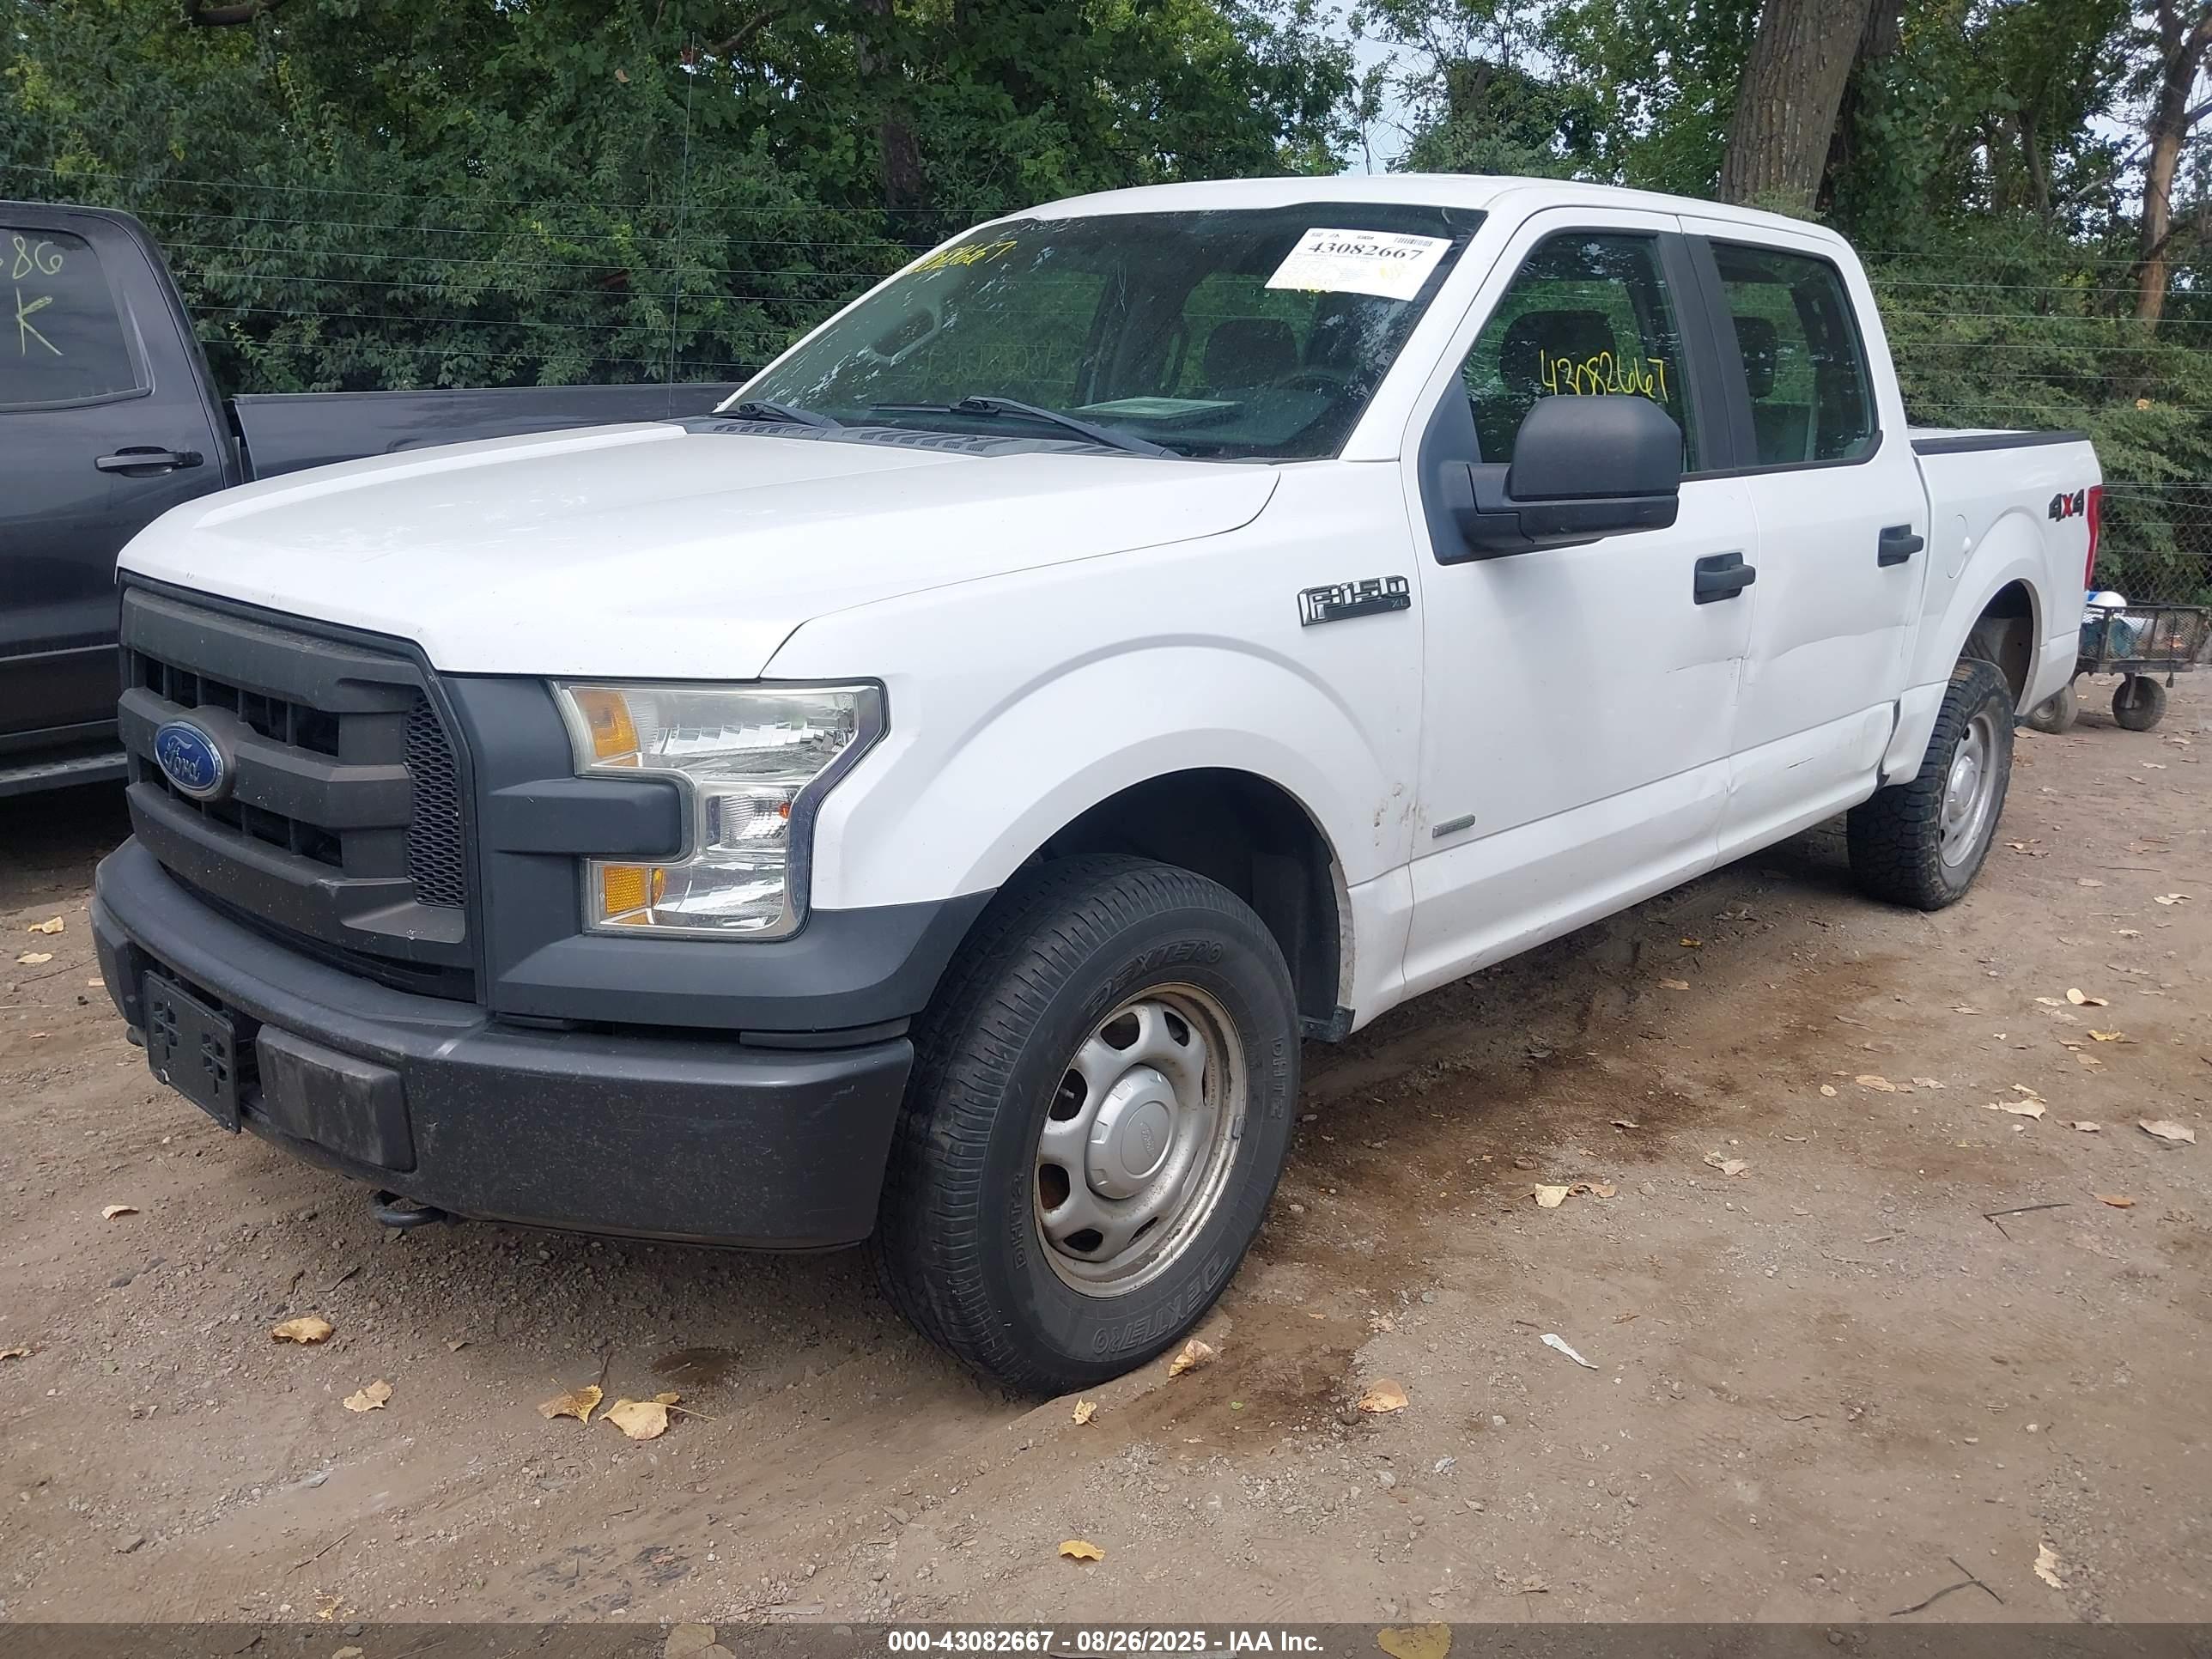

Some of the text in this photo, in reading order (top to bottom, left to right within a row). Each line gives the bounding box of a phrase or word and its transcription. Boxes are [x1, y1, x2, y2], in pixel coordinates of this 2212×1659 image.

[0, 235, 64, 280] 86
[1308, 241, 1425, 261] 43082667
[1540, 349, 1668, 404] 43082667
[163, 734, 202, 782] Ford
